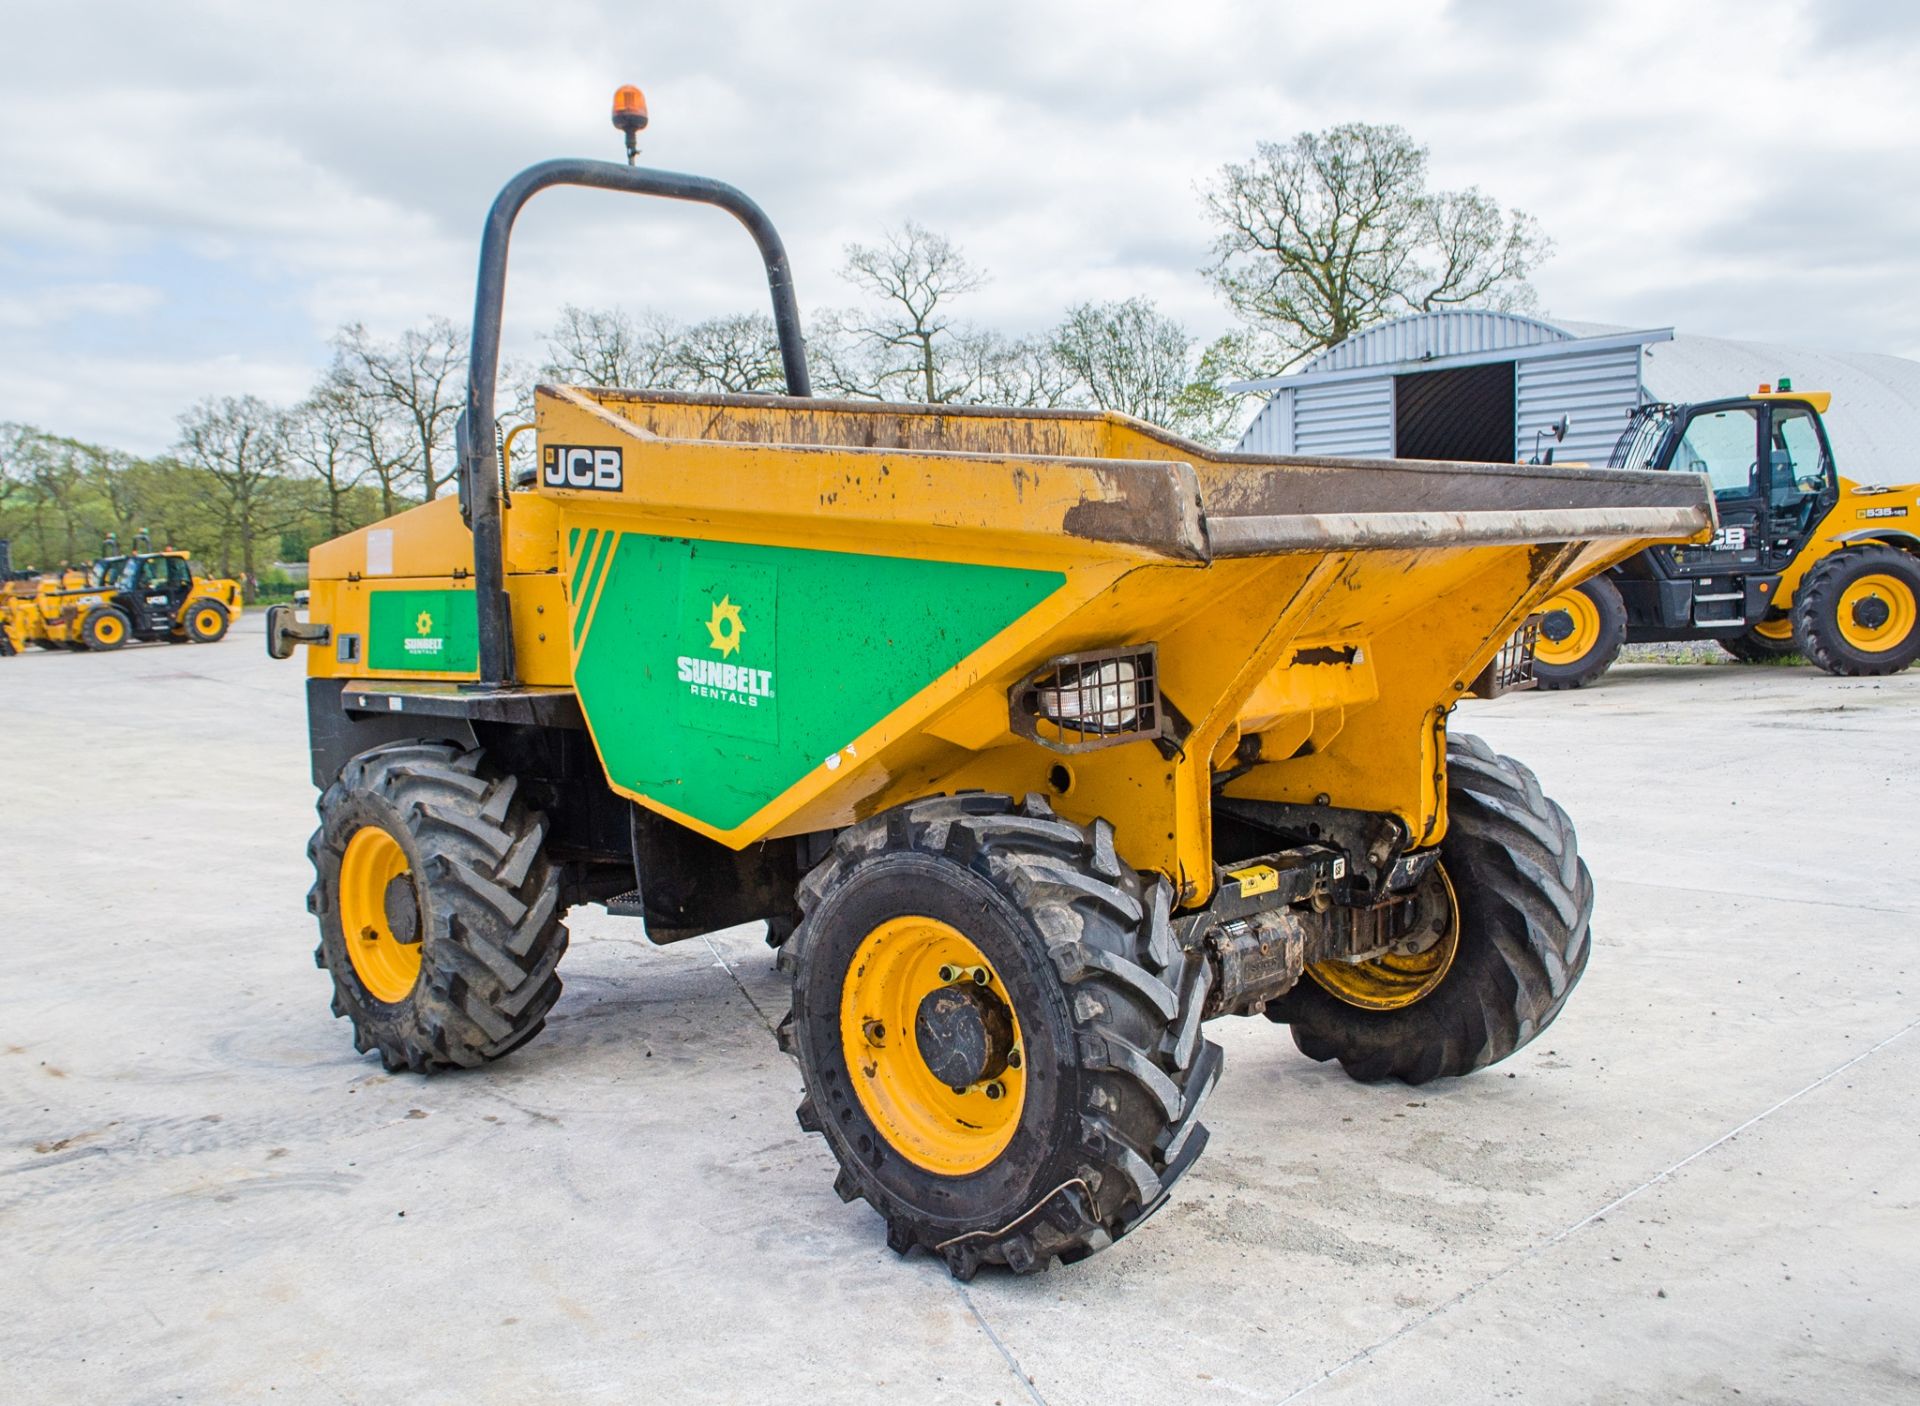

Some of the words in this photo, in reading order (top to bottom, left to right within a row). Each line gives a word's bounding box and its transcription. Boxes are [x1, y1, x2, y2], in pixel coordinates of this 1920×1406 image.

[545, 448, 621, 488] JCB
[1711, 528, 1746, 546] CB
[677, 656, 772, 697] SUNBELT
[690, 684, 758, 707] RENTALS
